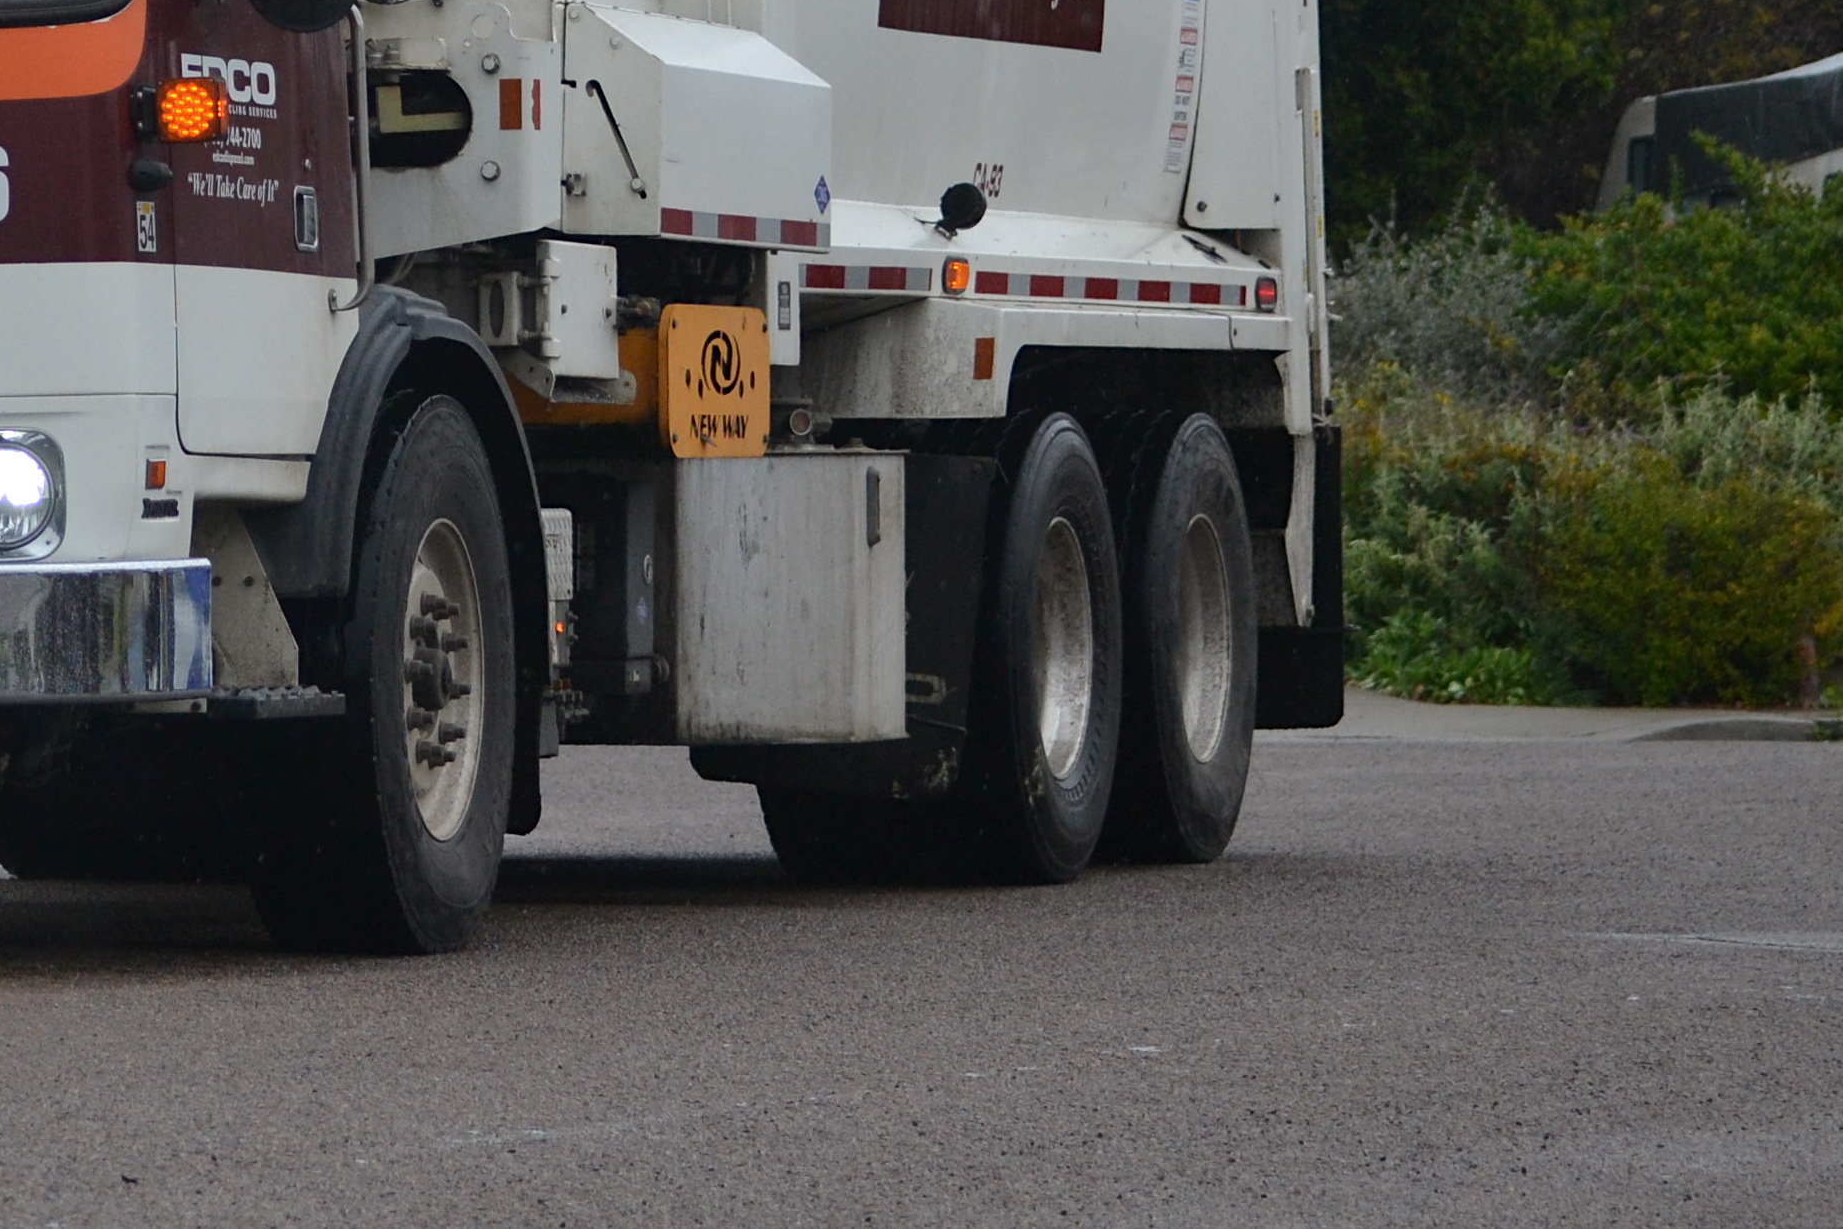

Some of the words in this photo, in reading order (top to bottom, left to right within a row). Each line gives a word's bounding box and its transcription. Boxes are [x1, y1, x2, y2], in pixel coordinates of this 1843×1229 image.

[248, 106, 278, 120] SERVICES
[215, 175, 236, 199] Take
[236, 176, 257, 201] Care
[257, 179, 269, 208] of
[139, 214, 155, 250] 54
[689, 414, 719, 439] NEW
[721, 414, 749, 440] WAY
